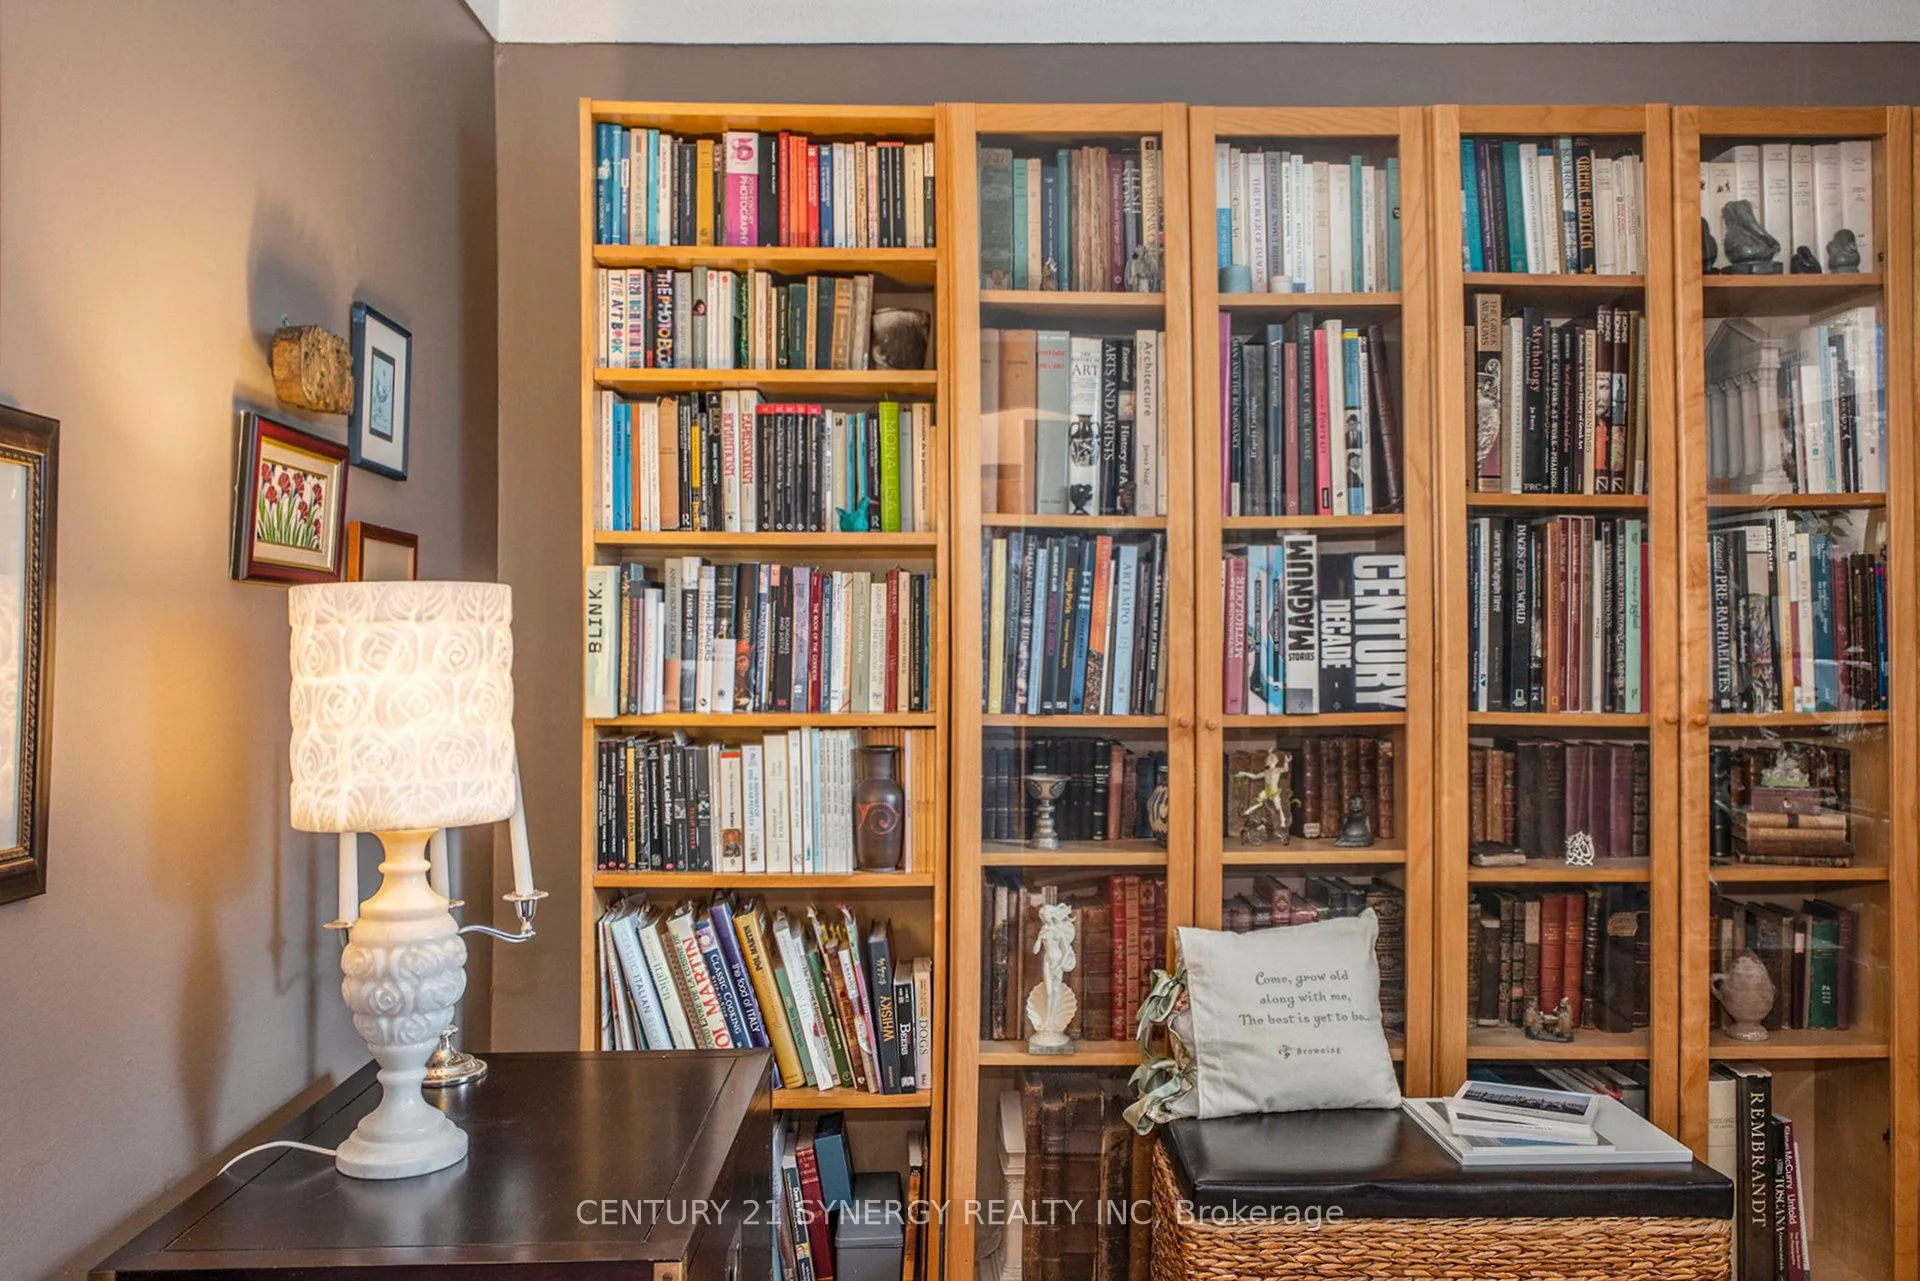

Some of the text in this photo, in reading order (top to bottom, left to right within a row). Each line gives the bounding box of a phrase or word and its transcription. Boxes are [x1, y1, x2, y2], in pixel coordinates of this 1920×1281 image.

[1562, 148, 1574, 200] KOURION
[738, 175, 749, 246] PHOTOGRAPHY
[1252, 198, 1262, 233] POWER
[1577, 156, 1594, 250] GREEK EROTICA
[656, 270, 672, 296] THE
[1255, 246, 1264, 284] IMAGES
[610, 322, 623, 354] BOOK
[1481, 300, 1490, 346] MUSEUMS
[1490, 317, 1498, 346] GREEK
[1597, 315, 1605, 335] GREC
[1072, 363, 1099, 376] ART
[1121, 346, 1131, 383] Essential
[1142, 341, 1154, 417] Architecture
[1303, 344, 1312, 389] TREASURES
[1529, 325, 1543, 393] Mythology
[1103, 344, 1117, 462] ARTS AND ARTISTS
[722, 412, 735, 476] ROMANTICISM
[742, 413, 754, 485] EXPRESSIONISM
[1119, 425, 1130, 461] History
[1304, 428, 1313, 461] LOUVRE
[1319, 411, 1328, 455] PORTRAIT
[885, 419, 898, 512] MONA LISA
[1550, 450, 1558, 489] PHAIDON
[1064, 567, 1075, 615] Helga Paris
[1121, 562, 1133, 625] ARTEMPO
[1154, 575, 1162, 604] SAHEL
[1285, 540, 1316, 652] MAGNUM
[1516, 524, 1527, 625] IMAGES WORLD
[587, 582, 603, 653] BLINK.
[685, 593, 694, 641] FAKING DEATH
[704, 590, 714, 663] IMAGE MAKERS
[811, 603, 819, 615] THE
[811, 615, 819, 631] BOOK
[1234, 575, 1245, 658] MYTHOLOGIE
[1354, 554, 1406, 709] CENTURY
[1714, 534, 1731, 693] Essential PRE-RAPHAELITES
[1320, 599, 1352, 669] DECADE
[1287, 652, 1315, 662] STORIES
[664, 803, 673, 826] Society
[743, 925, 758, 956] MARTIN
[653, 961, 673, 1002] italien
[682, 935, 721, 1018] MARTIN
[731, 962, 743, 978] the
[736, 977, 749, 999] food
[1255, 970, 1350, 988] Come, grow old
[632, 974, 652, 1015] ITALIAN
[709, 953, 742, 1036] CLASSIC COOKING
[1259, 991, 1353, 1009] along with me,
[746, 1008, 761, 1034] ITALY
[878, 995, 897, 1043] WHISKY
[918, 1019, 930, 1056] DOGS
[1238, 1012, 1350, 1029] The best is yet to
[1749, 1091, 1768, 1229] REMBRANDT
[1774, 1176, 1786, 1233] TOSCANA
[1785, 1150, 1798, 1225] McCurry Untold
